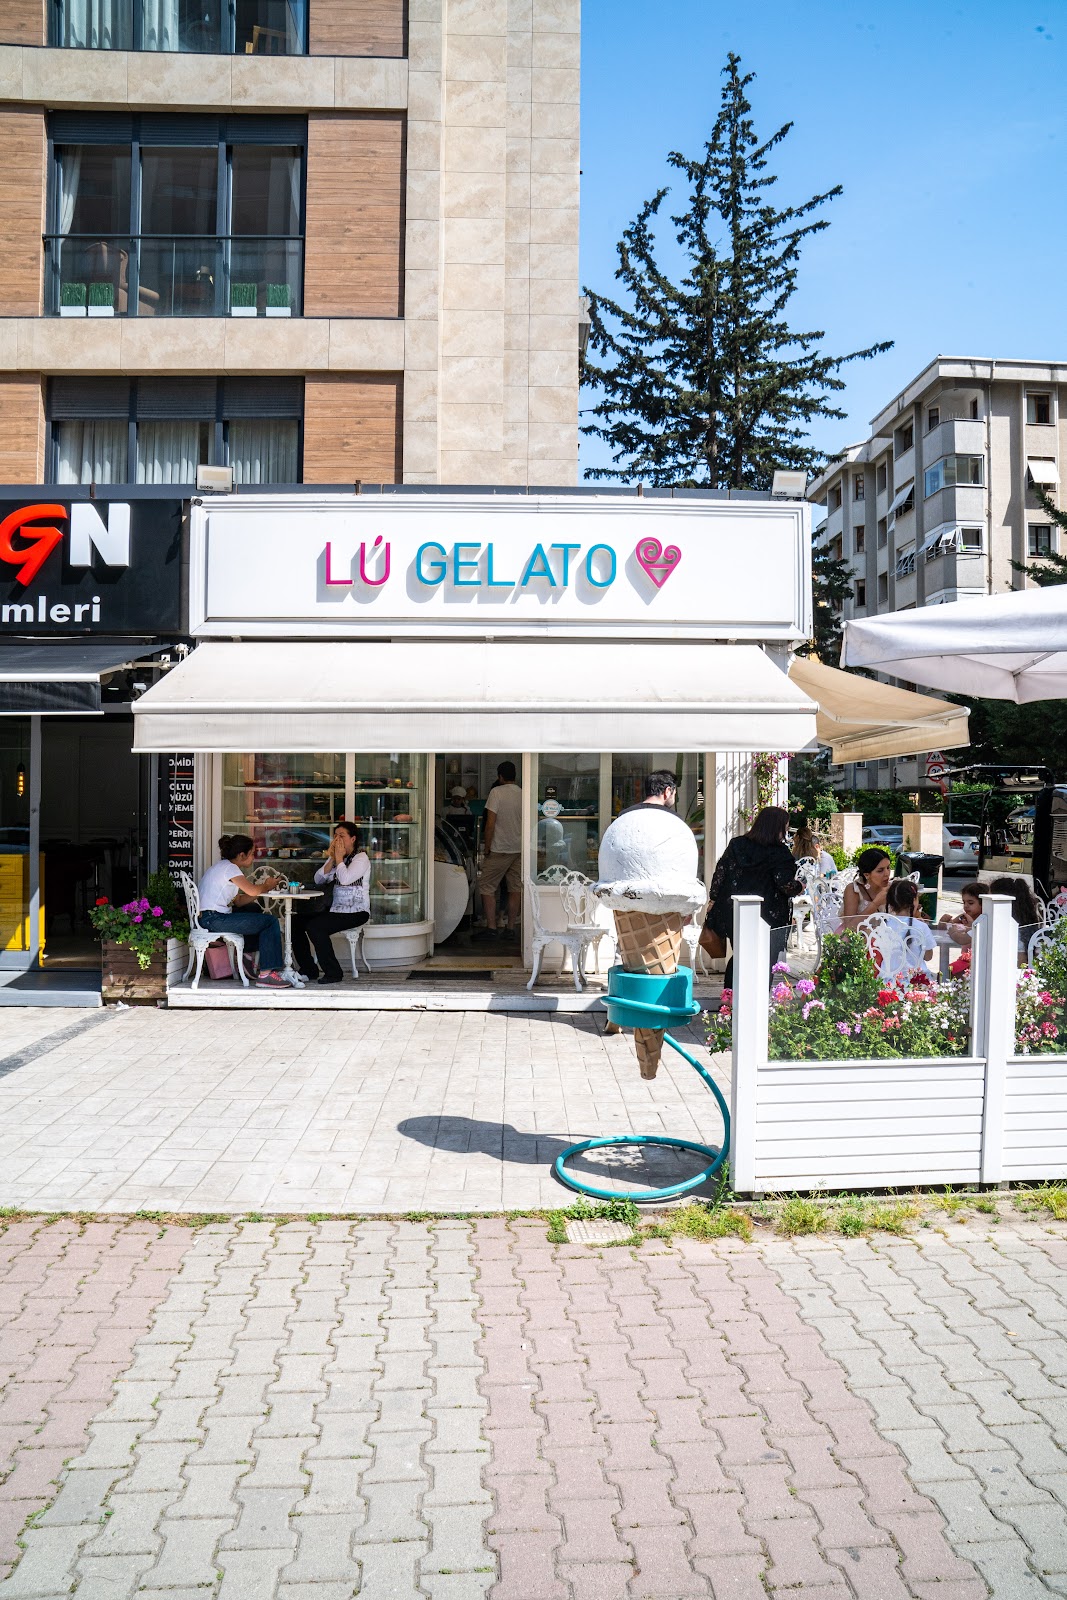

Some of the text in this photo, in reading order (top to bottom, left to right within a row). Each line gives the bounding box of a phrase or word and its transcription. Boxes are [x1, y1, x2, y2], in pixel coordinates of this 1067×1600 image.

[325, 535, 617, 588] LÚ GELATO
[1, 595, 101, 622] mleri
